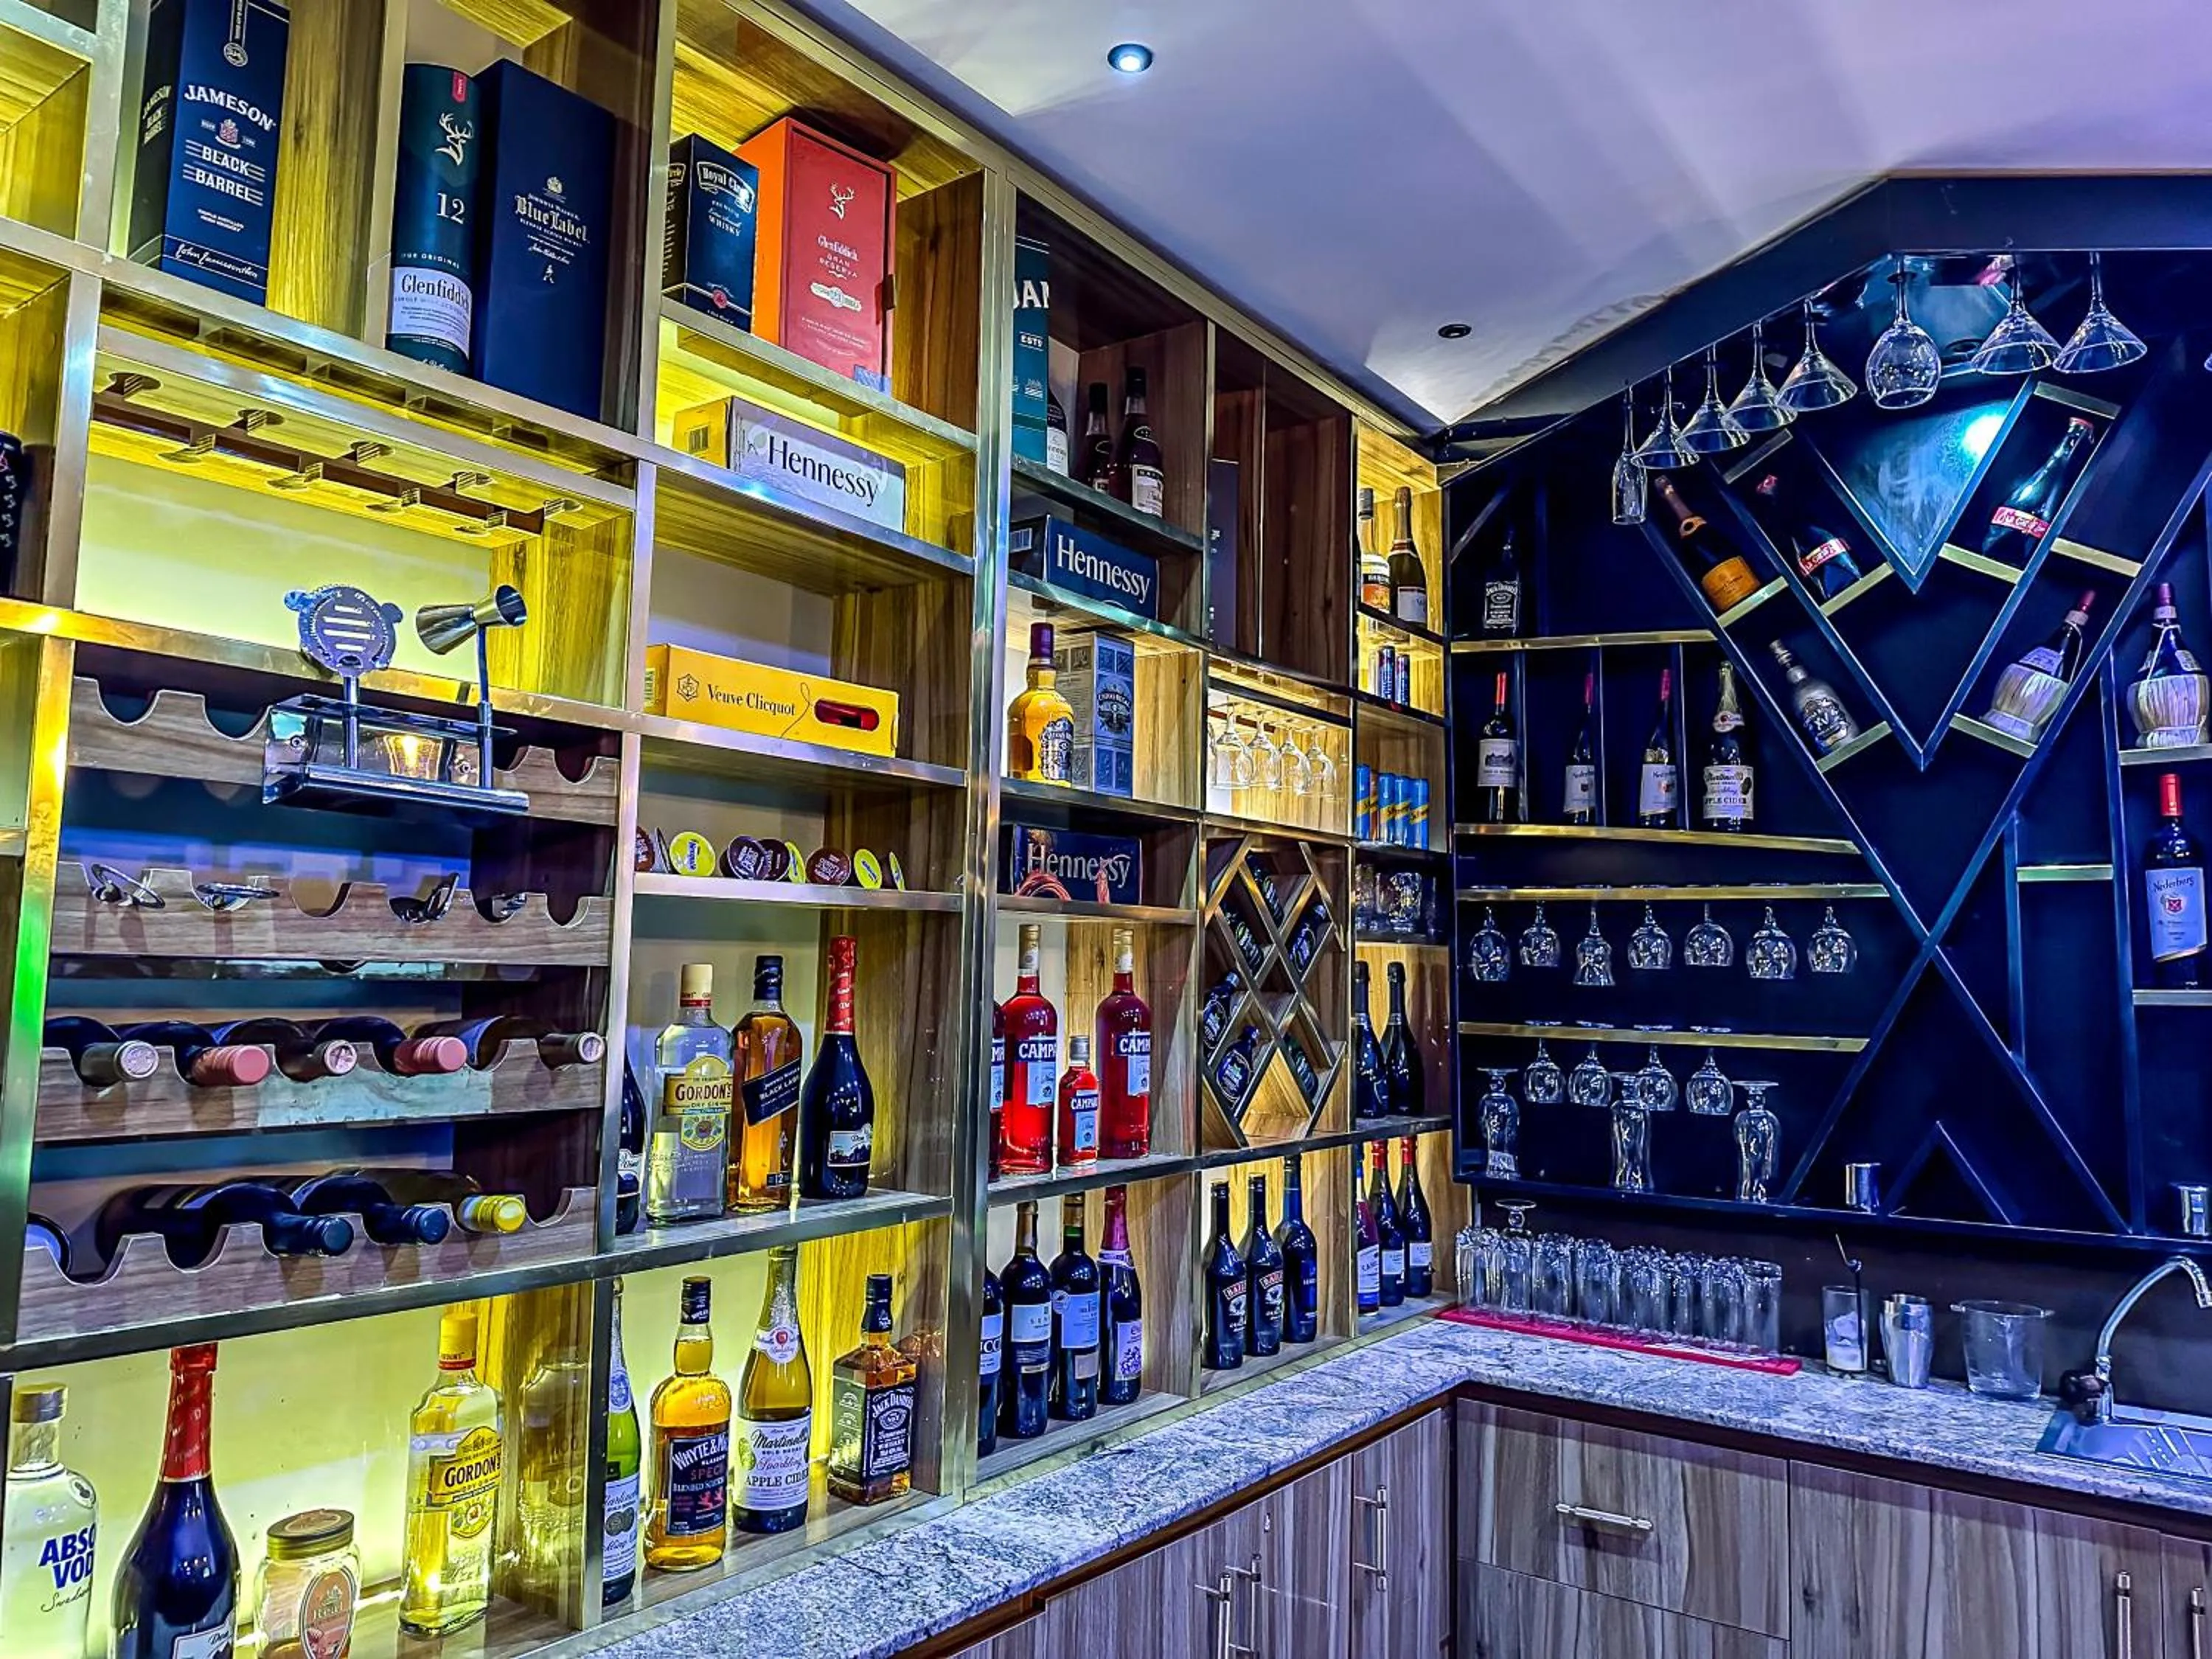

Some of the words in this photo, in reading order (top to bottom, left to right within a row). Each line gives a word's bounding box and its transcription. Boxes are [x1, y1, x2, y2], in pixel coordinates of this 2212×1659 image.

[184, 85, 274, 131] JAMESON
[202, 146, 249, 176] BLACK
[702, 167, 726, 185] Royal
[195, 168, 251, 201] BARREL
[437, 192, 465, 224] 12
[515, 195, 549, 224] Blue
[549, 210, 587, 241] Label
[709, 215, 740, 237] WHISKY
[768, 436, 878, 507] Hennessy
[1057, 534, 1150, 604] Hennessy
[707, 684, 742, 706] Veuve
[745, 692, 796, 716] Clicquot
[1027, 843, 1130, 888] Hennesy
[675, 1082, 732, 1102] GORDON'S
[775, 1174, 784, 1183] 12
[444, 1453, 501, 1488] GORDON'S
[672, 1441, 709, 1470] WHYTE
[745, 1475, 782, 1486] APPLE
[52, 1549, 94, 1589] VOD
